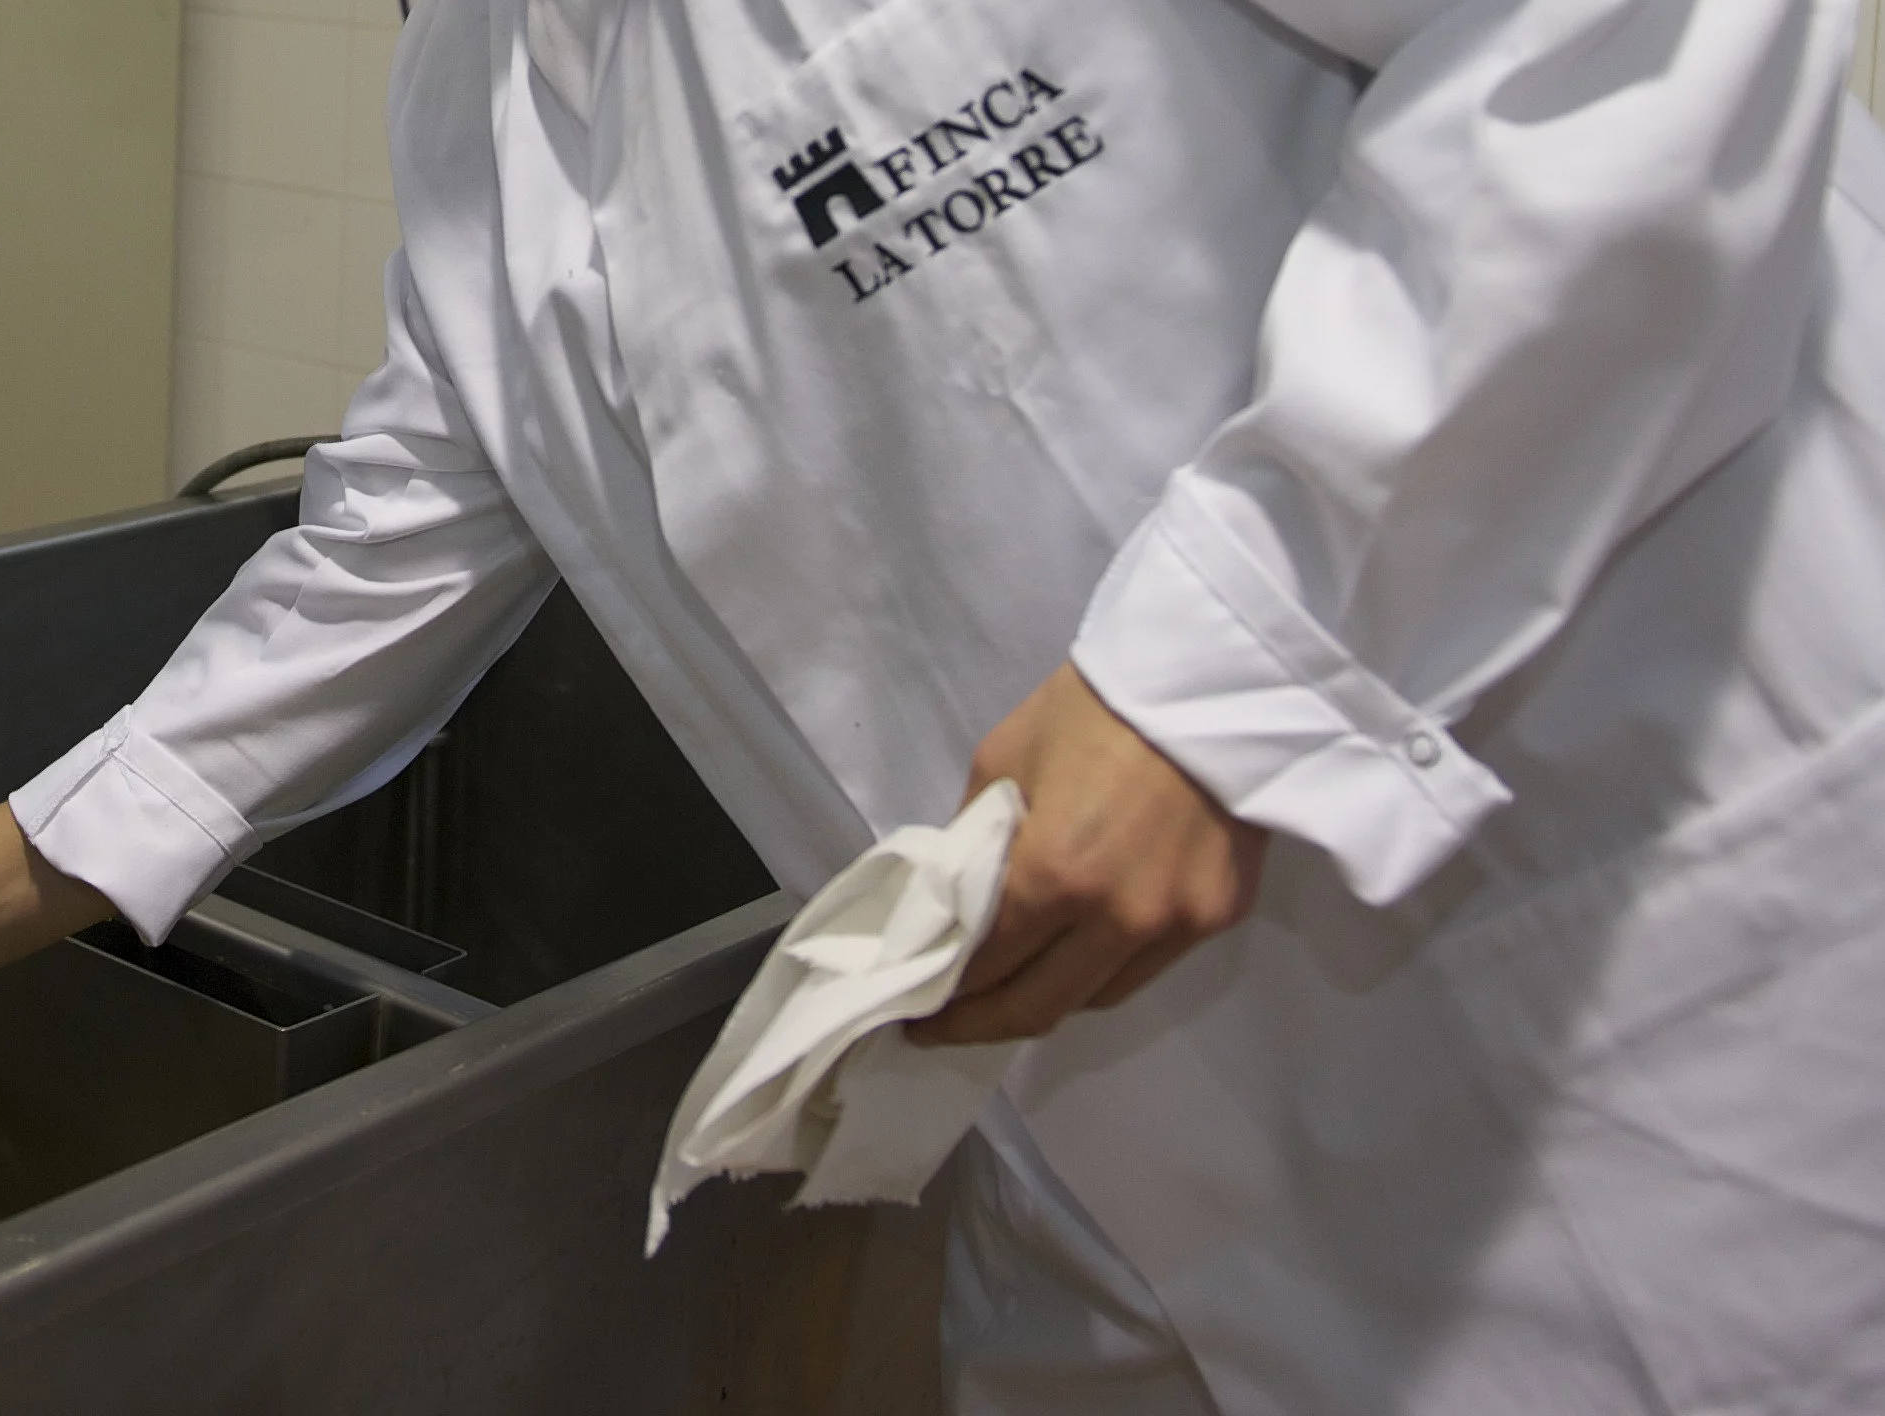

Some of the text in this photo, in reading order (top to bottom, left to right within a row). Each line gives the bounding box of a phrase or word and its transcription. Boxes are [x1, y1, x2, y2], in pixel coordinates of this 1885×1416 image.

[832, 115, 1105, 303] LA TORRE
[873, 68, 1065, 198] FINCA
